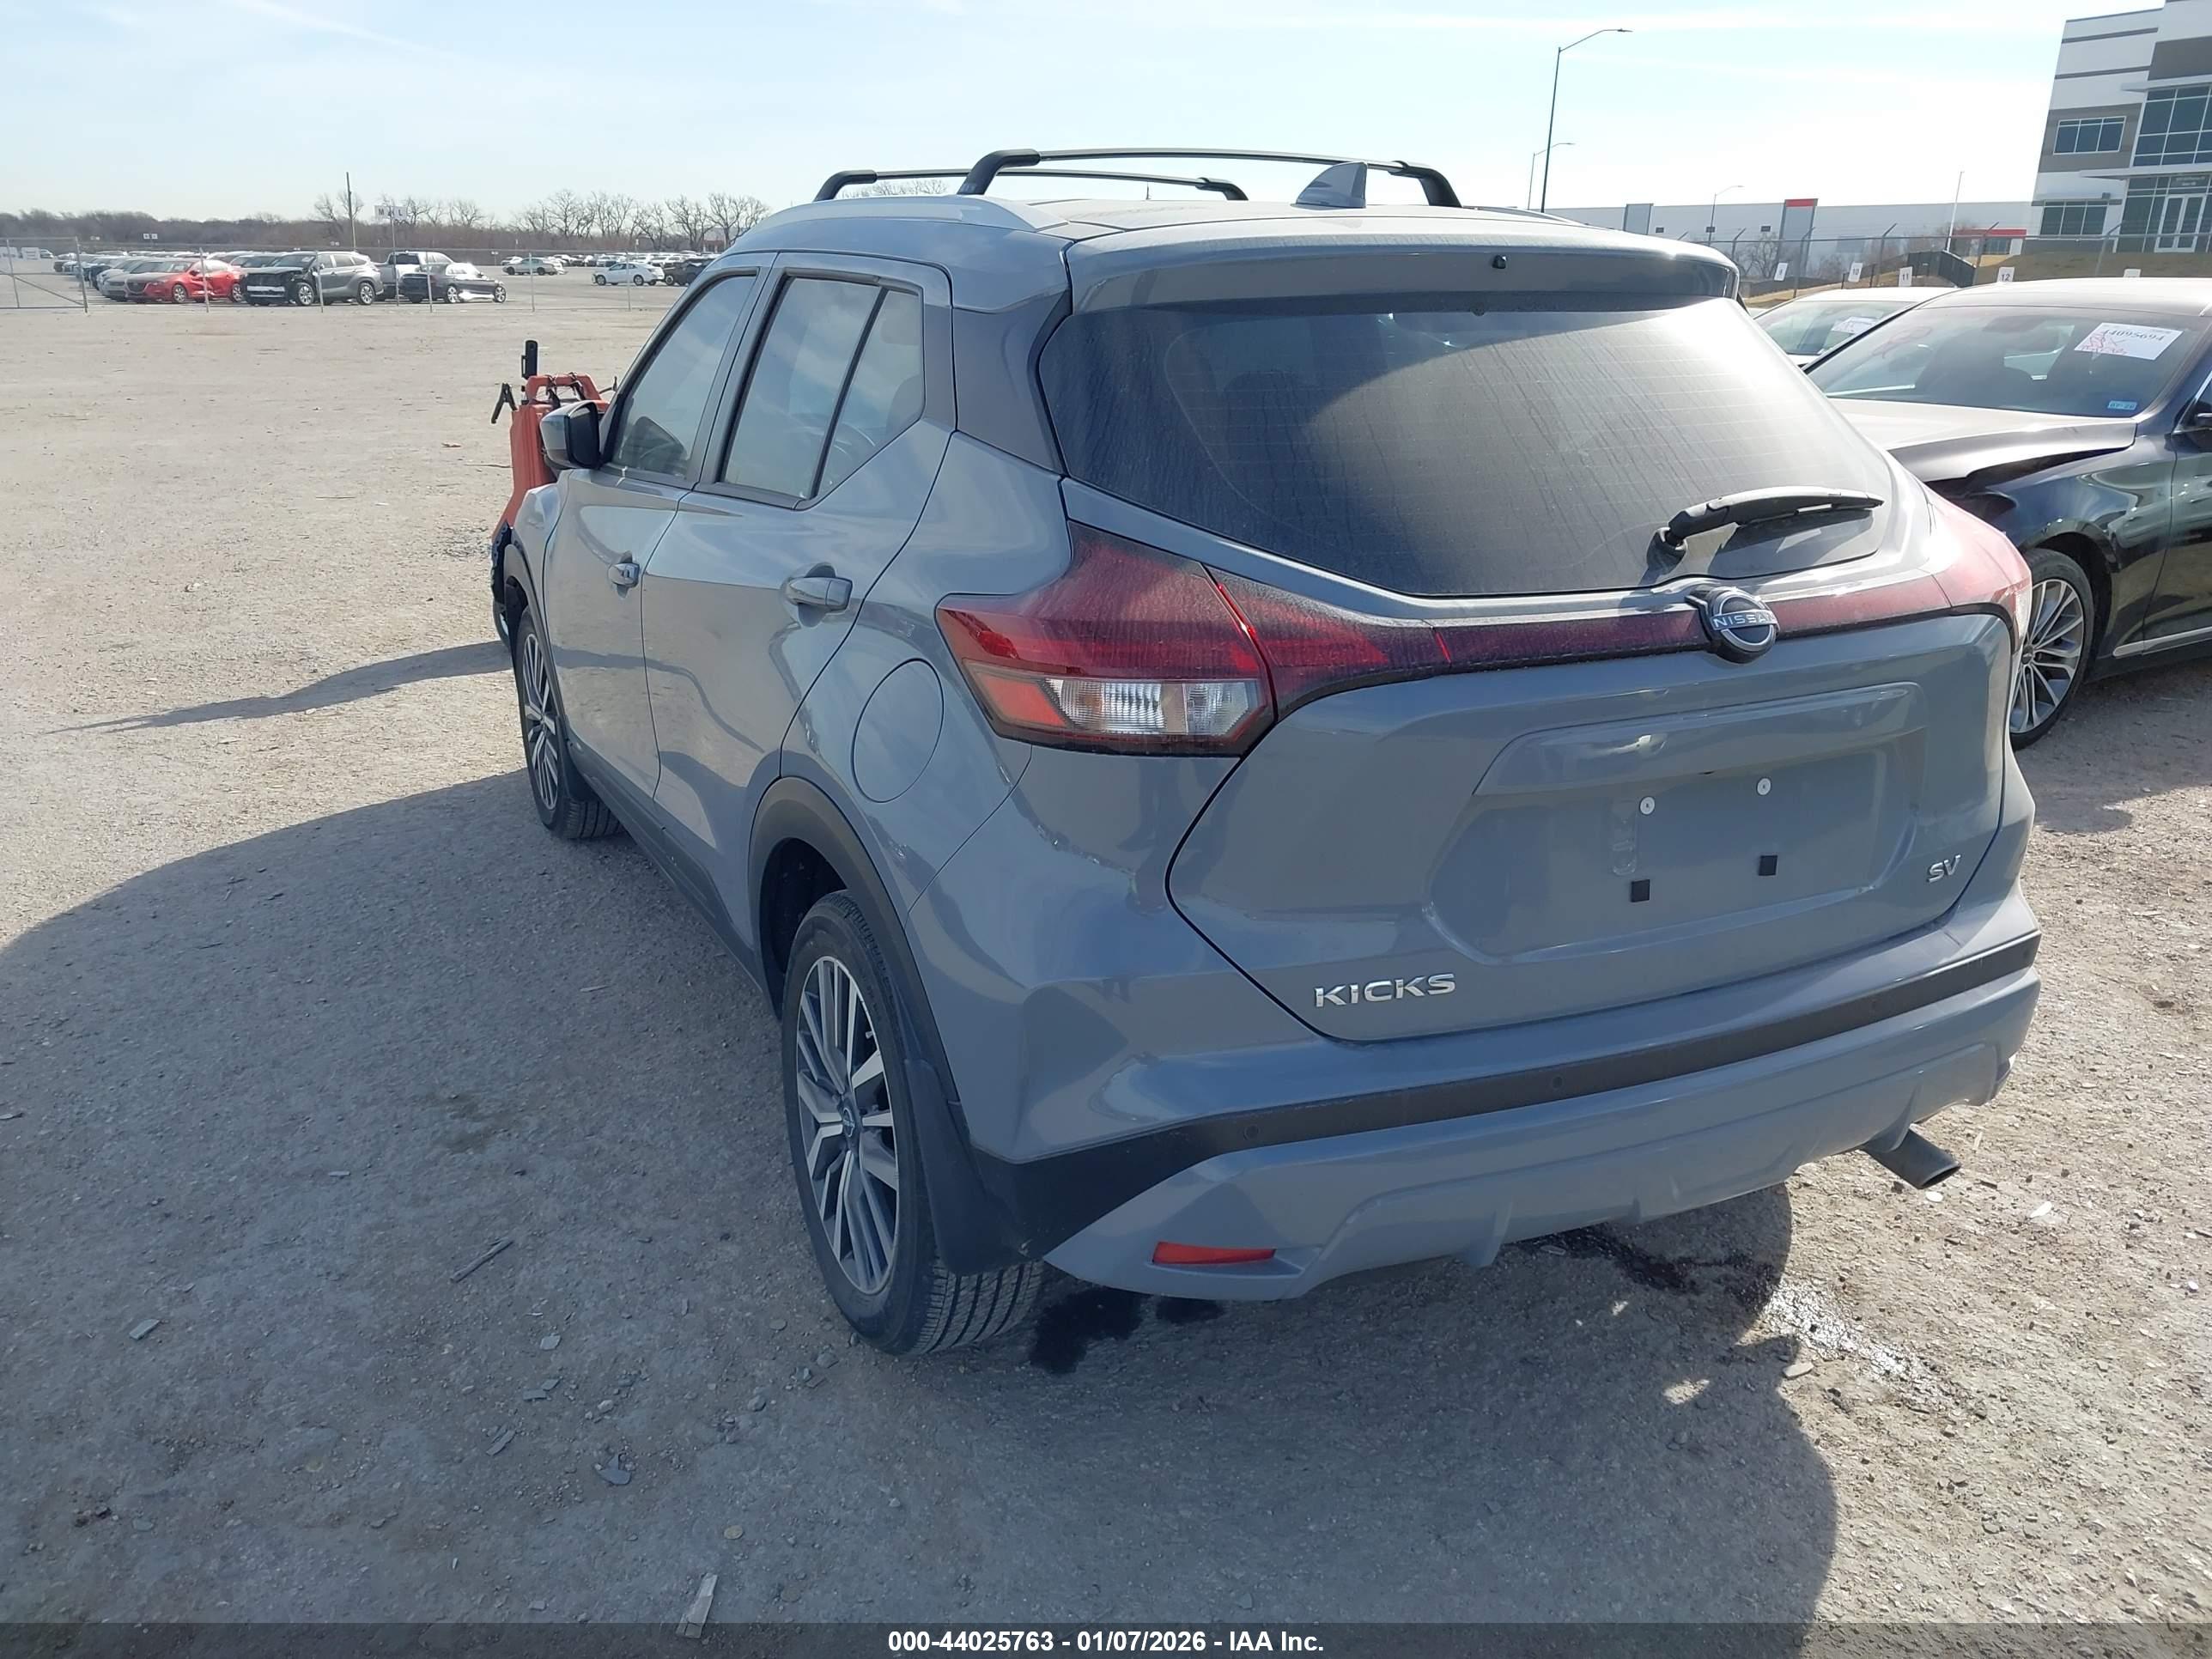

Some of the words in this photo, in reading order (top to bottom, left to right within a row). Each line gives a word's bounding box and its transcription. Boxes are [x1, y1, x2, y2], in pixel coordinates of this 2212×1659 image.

[2001, 273, 2010, 282] 12
[1713, 612, 1777, 628] NISSAN
[1929, 854, 1961, 883] SV
[1314, 973, 1456, 1007] KICKS
